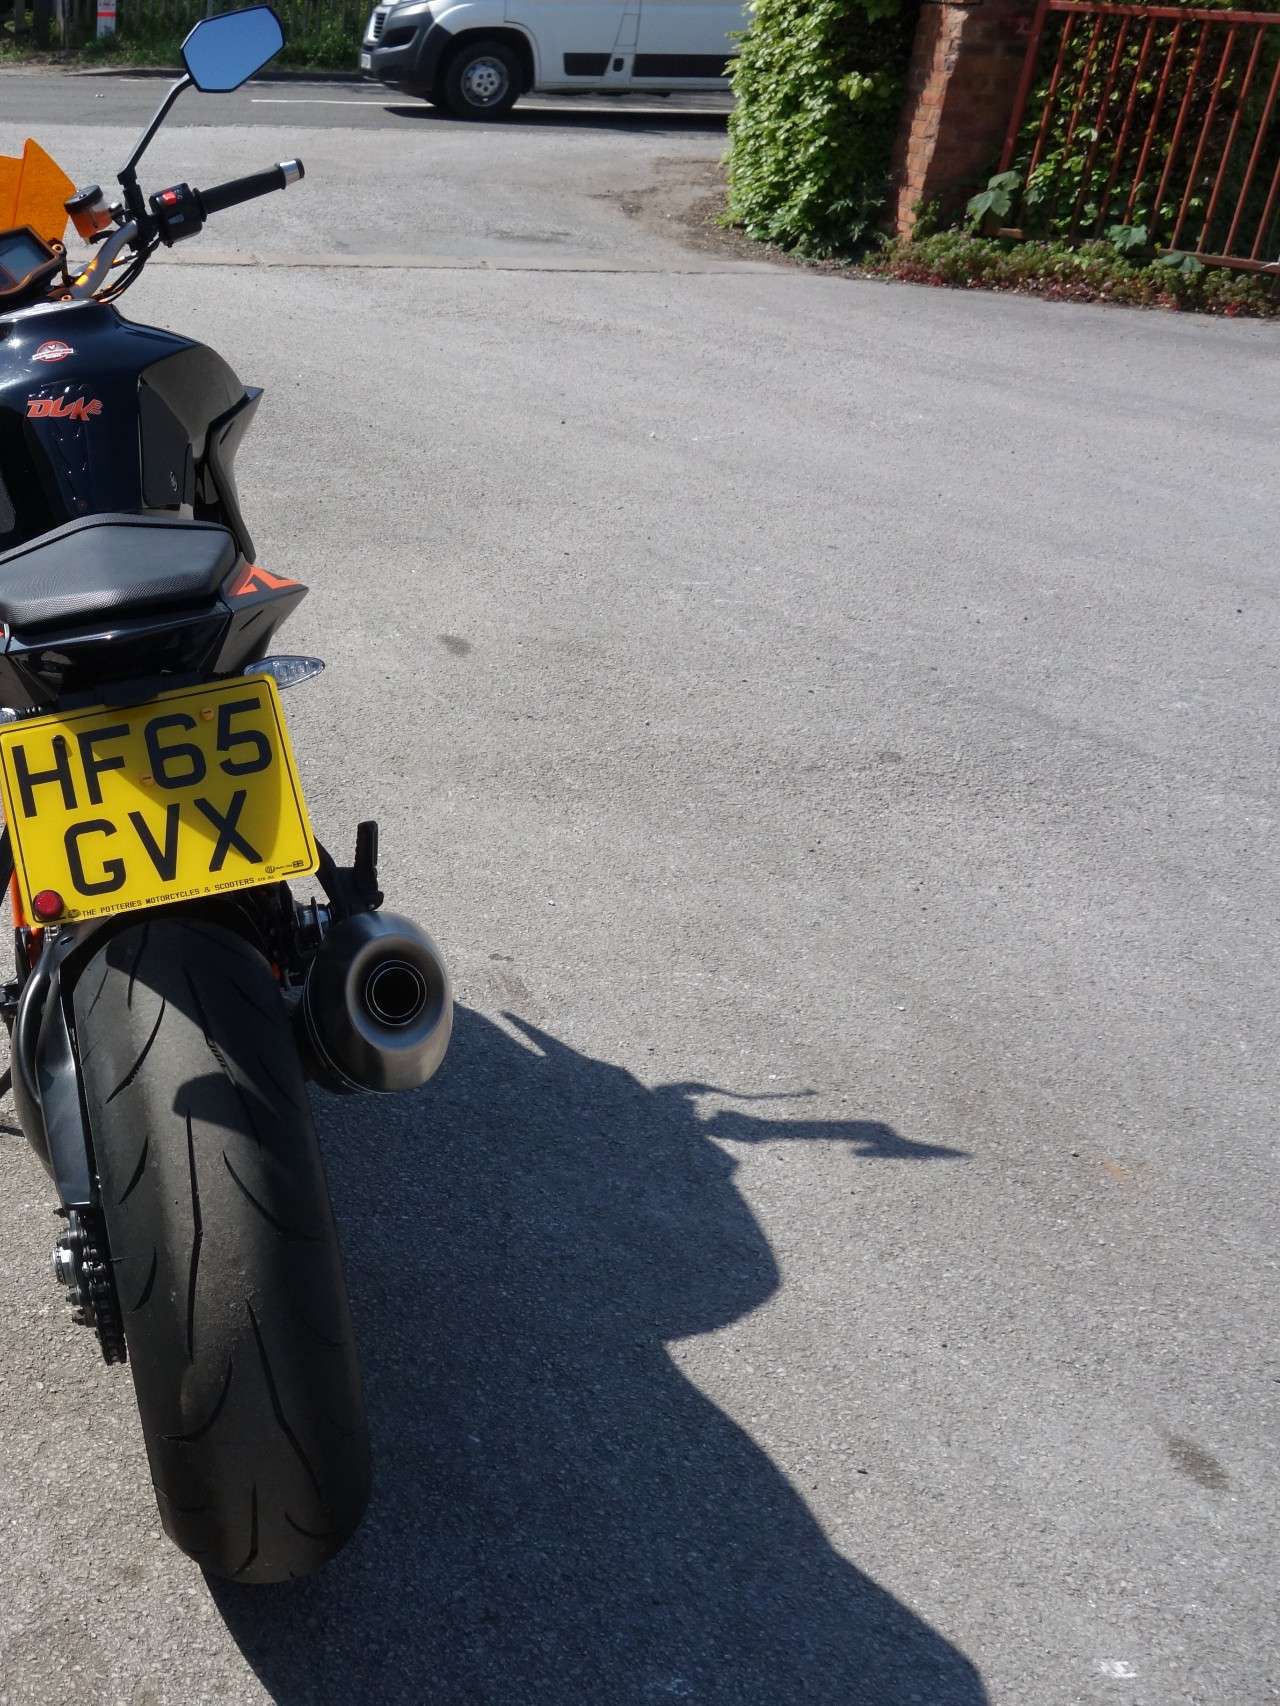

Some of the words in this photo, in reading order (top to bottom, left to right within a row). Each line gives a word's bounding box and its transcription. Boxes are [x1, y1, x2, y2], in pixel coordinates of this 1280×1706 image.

[11, 697, 273, 819] HF65
[63, 789, 264, 897] GVX
[82, 909, 98, 918] THE
[100, 899, 142, 914] POTTERIES
[145, 888, 200, 905] MOTORCYCLES
[214, 877, 255, 891] SCOOTERS
